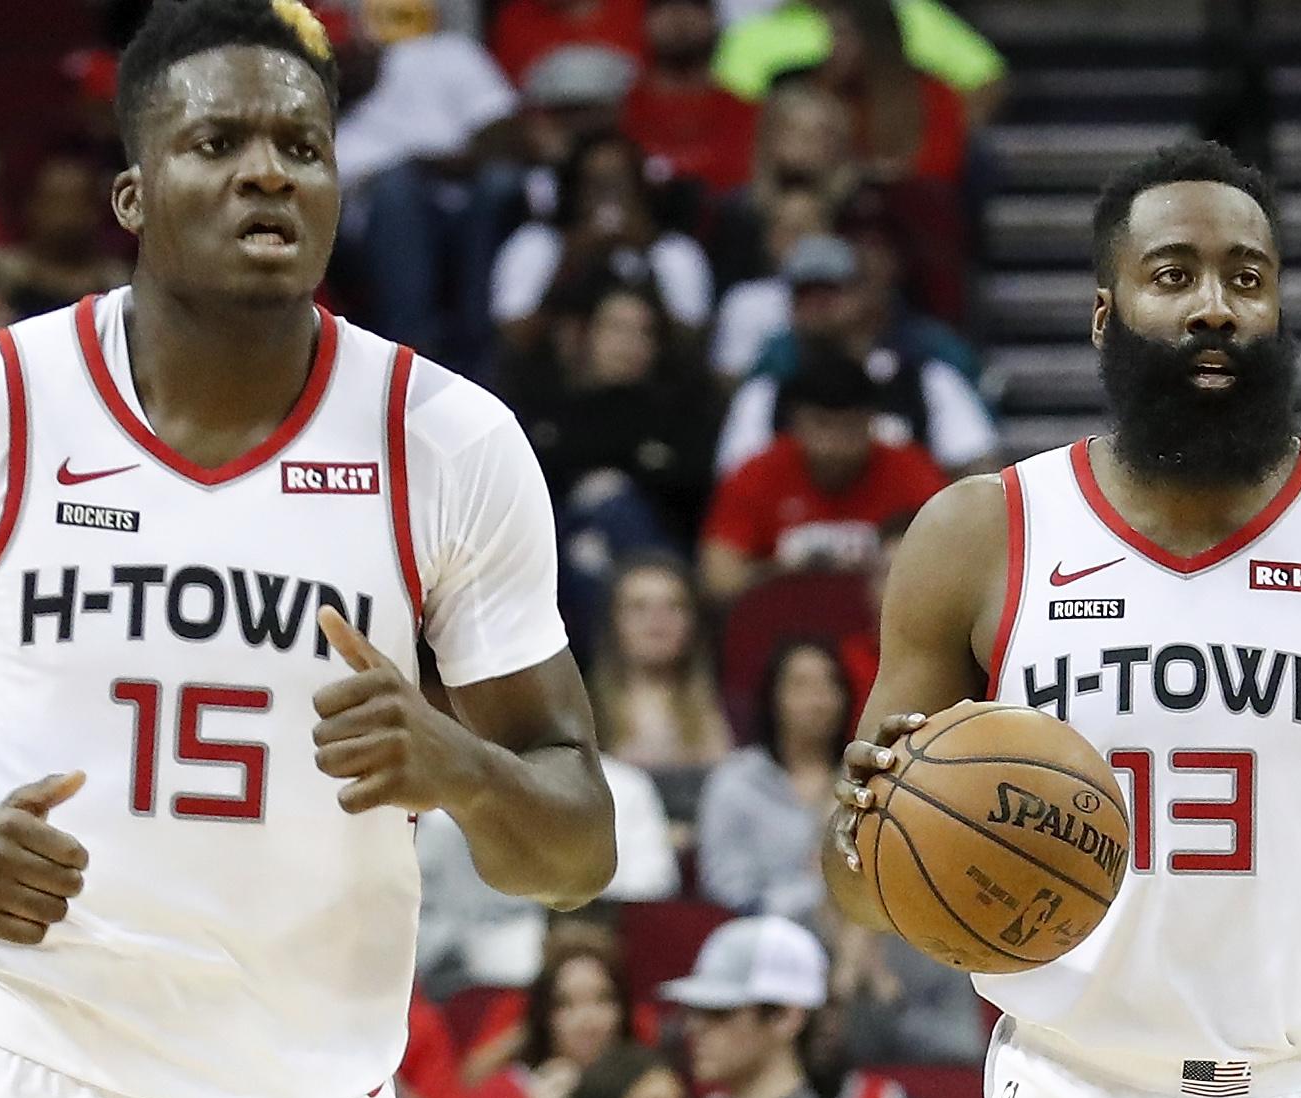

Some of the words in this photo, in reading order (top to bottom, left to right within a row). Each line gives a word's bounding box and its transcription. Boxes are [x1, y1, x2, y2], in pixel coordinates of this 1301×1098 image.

[62, 504, 135, 530] ROCKETS
[19, 563, 374, 661] H-TOWN
[1054, 601, 1119, 618] ROCKETS
[110, 677, 274, 824] 15
[987, 782, 1126, 886] SPALDIN
[1108, 747, 1258, 876] 13
